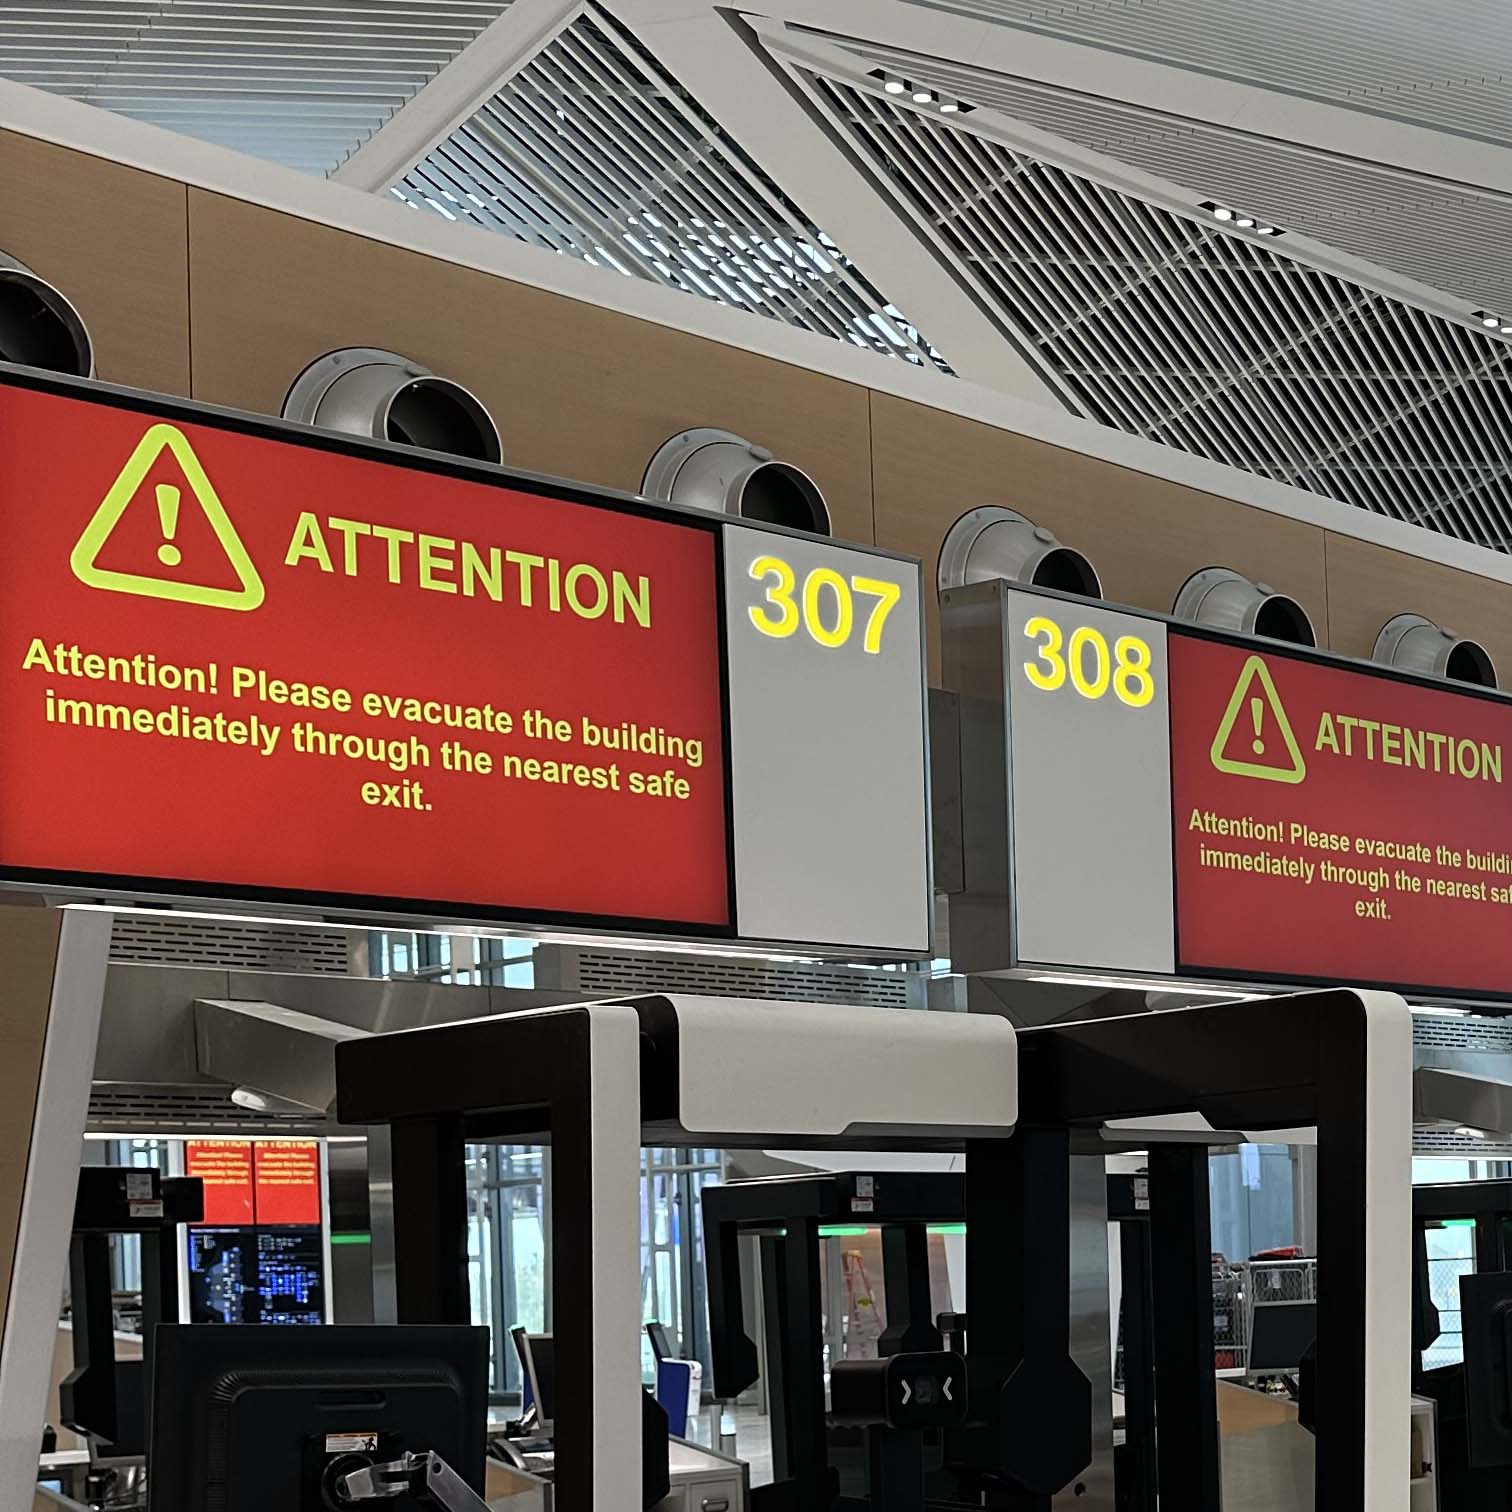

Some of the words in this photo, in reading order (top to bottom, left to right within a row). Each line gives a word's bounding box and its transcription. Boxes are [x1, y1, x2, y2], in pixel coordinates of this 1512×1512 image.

[284, 510, 651, 628] ATTENTION
[748, 553, 903, 656] 307
[22, 638, 218, 695] Attention!
[232, 666, 352, 712] Please
[362, 693, 513, 734] evacuate
[522, 709, 572, 742] the
[582, 716, 703, 768] building
[1022, 615, 1156, 709] 308
[46, 688, 281, 756] immediately
[291, 722, 430, 772] through
[440, 741, 493, 775] the
[503, 755, 620, 791] nearest
[628, 770, 690, 800] safe
[1314, 711, 1502, 784] ATTENTION
[361, 778, 432, 811] exit.
[1188, 808, 1284, 843] Attention!
[1290, 822, 1350, 853] Please
[1355, 837, 1432, 864] evacuate
[1435, 845, 1462, 868] the
[1200, 843, 1315, 885] immediately
[1319, 860, 1390, 893] through
[1394, 869, 1422, 893] the
[1426, 878, 1487, 901] nearest
[1354, 897, 1391, 920] exit.
